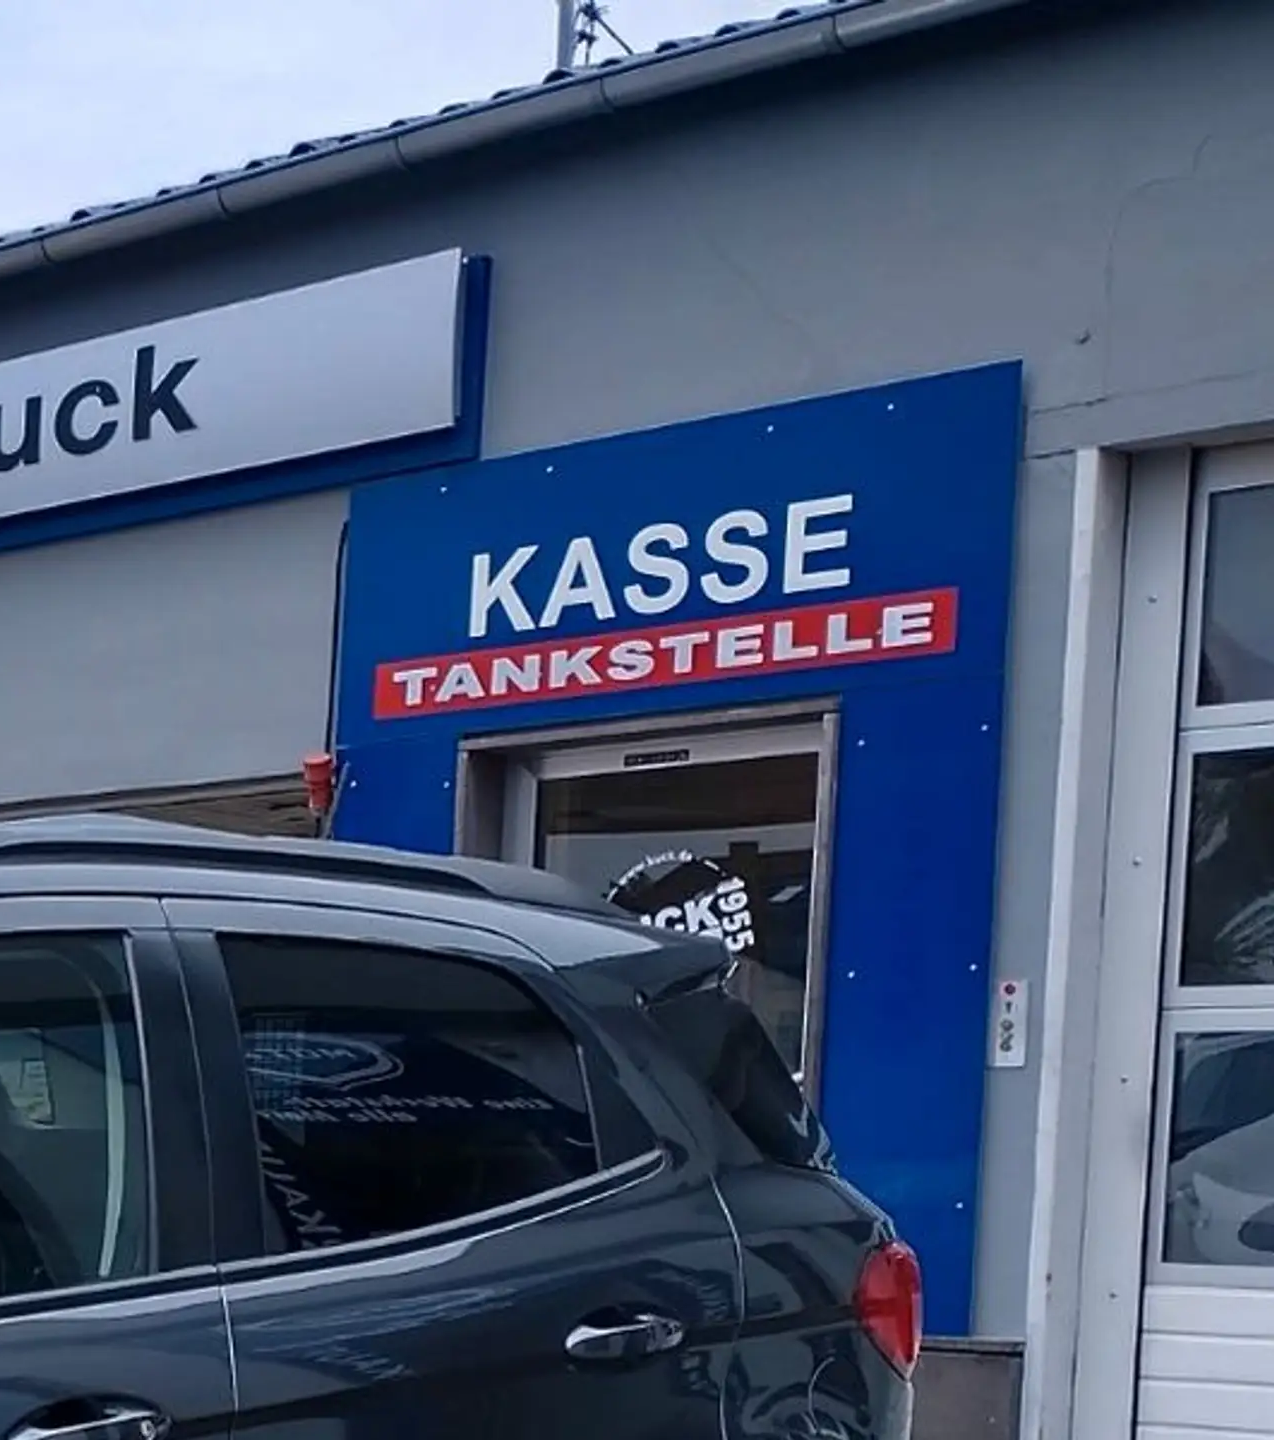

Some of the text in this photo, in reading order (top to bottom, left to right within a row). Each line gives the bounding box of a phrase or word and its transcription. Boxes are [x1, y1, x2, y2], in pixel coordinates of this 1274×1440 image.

[468, 494, 854, 638] KASSE
[391, 602, 935, 708] TANKSTELLE
[715, 875, 755, 952] 1955
